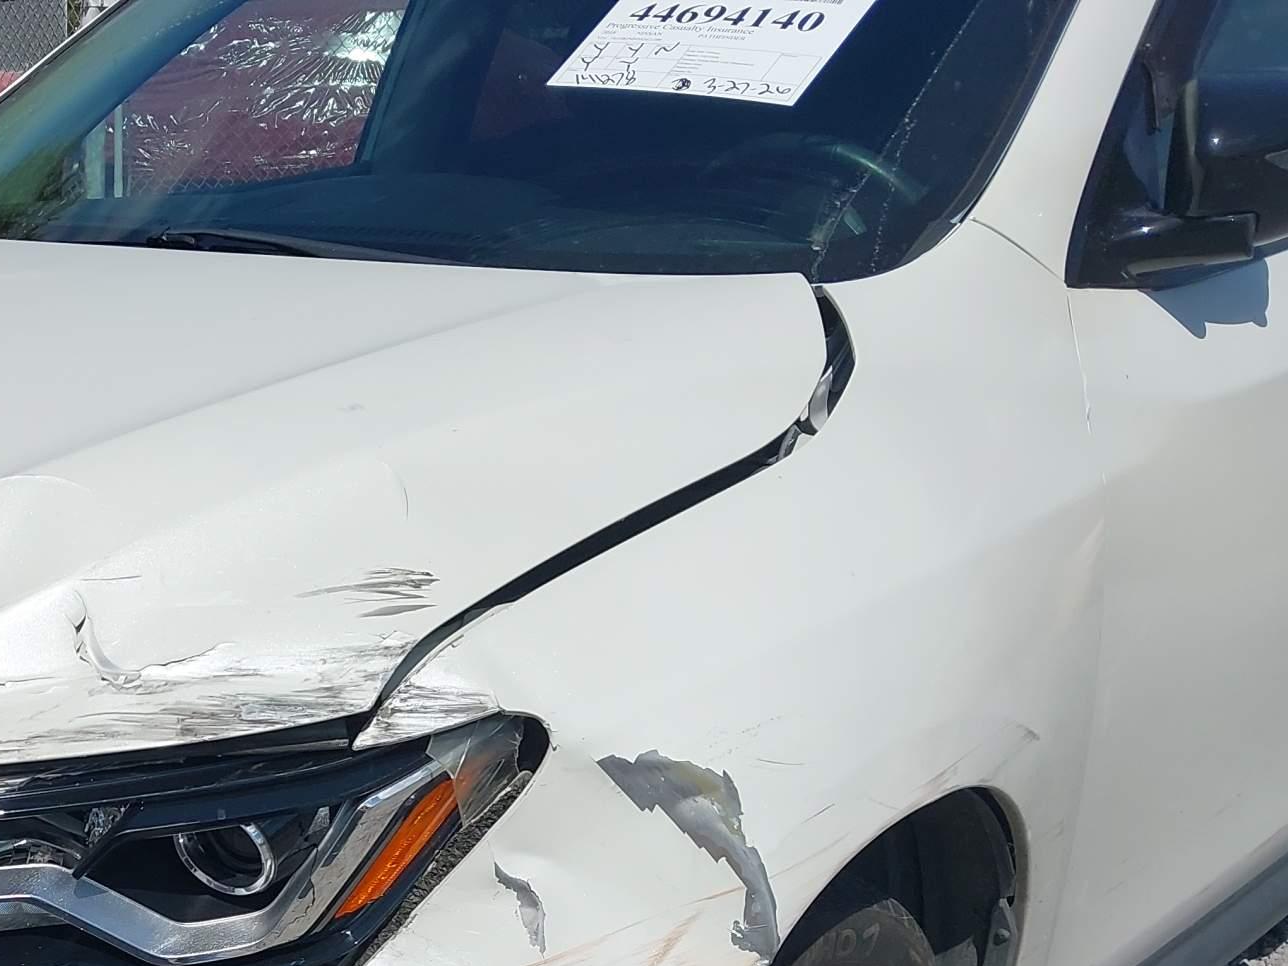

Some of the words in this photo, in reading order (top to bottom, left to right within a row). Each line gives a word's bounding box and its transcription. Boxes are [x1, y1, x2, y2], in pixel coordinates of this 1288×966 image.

[629, 3, 825, 32] 44694140
[606, 22, 661, 31] Progressive
[662, 24, 703, 33] Casualty
[707, 26, 754, 35] Insurance
